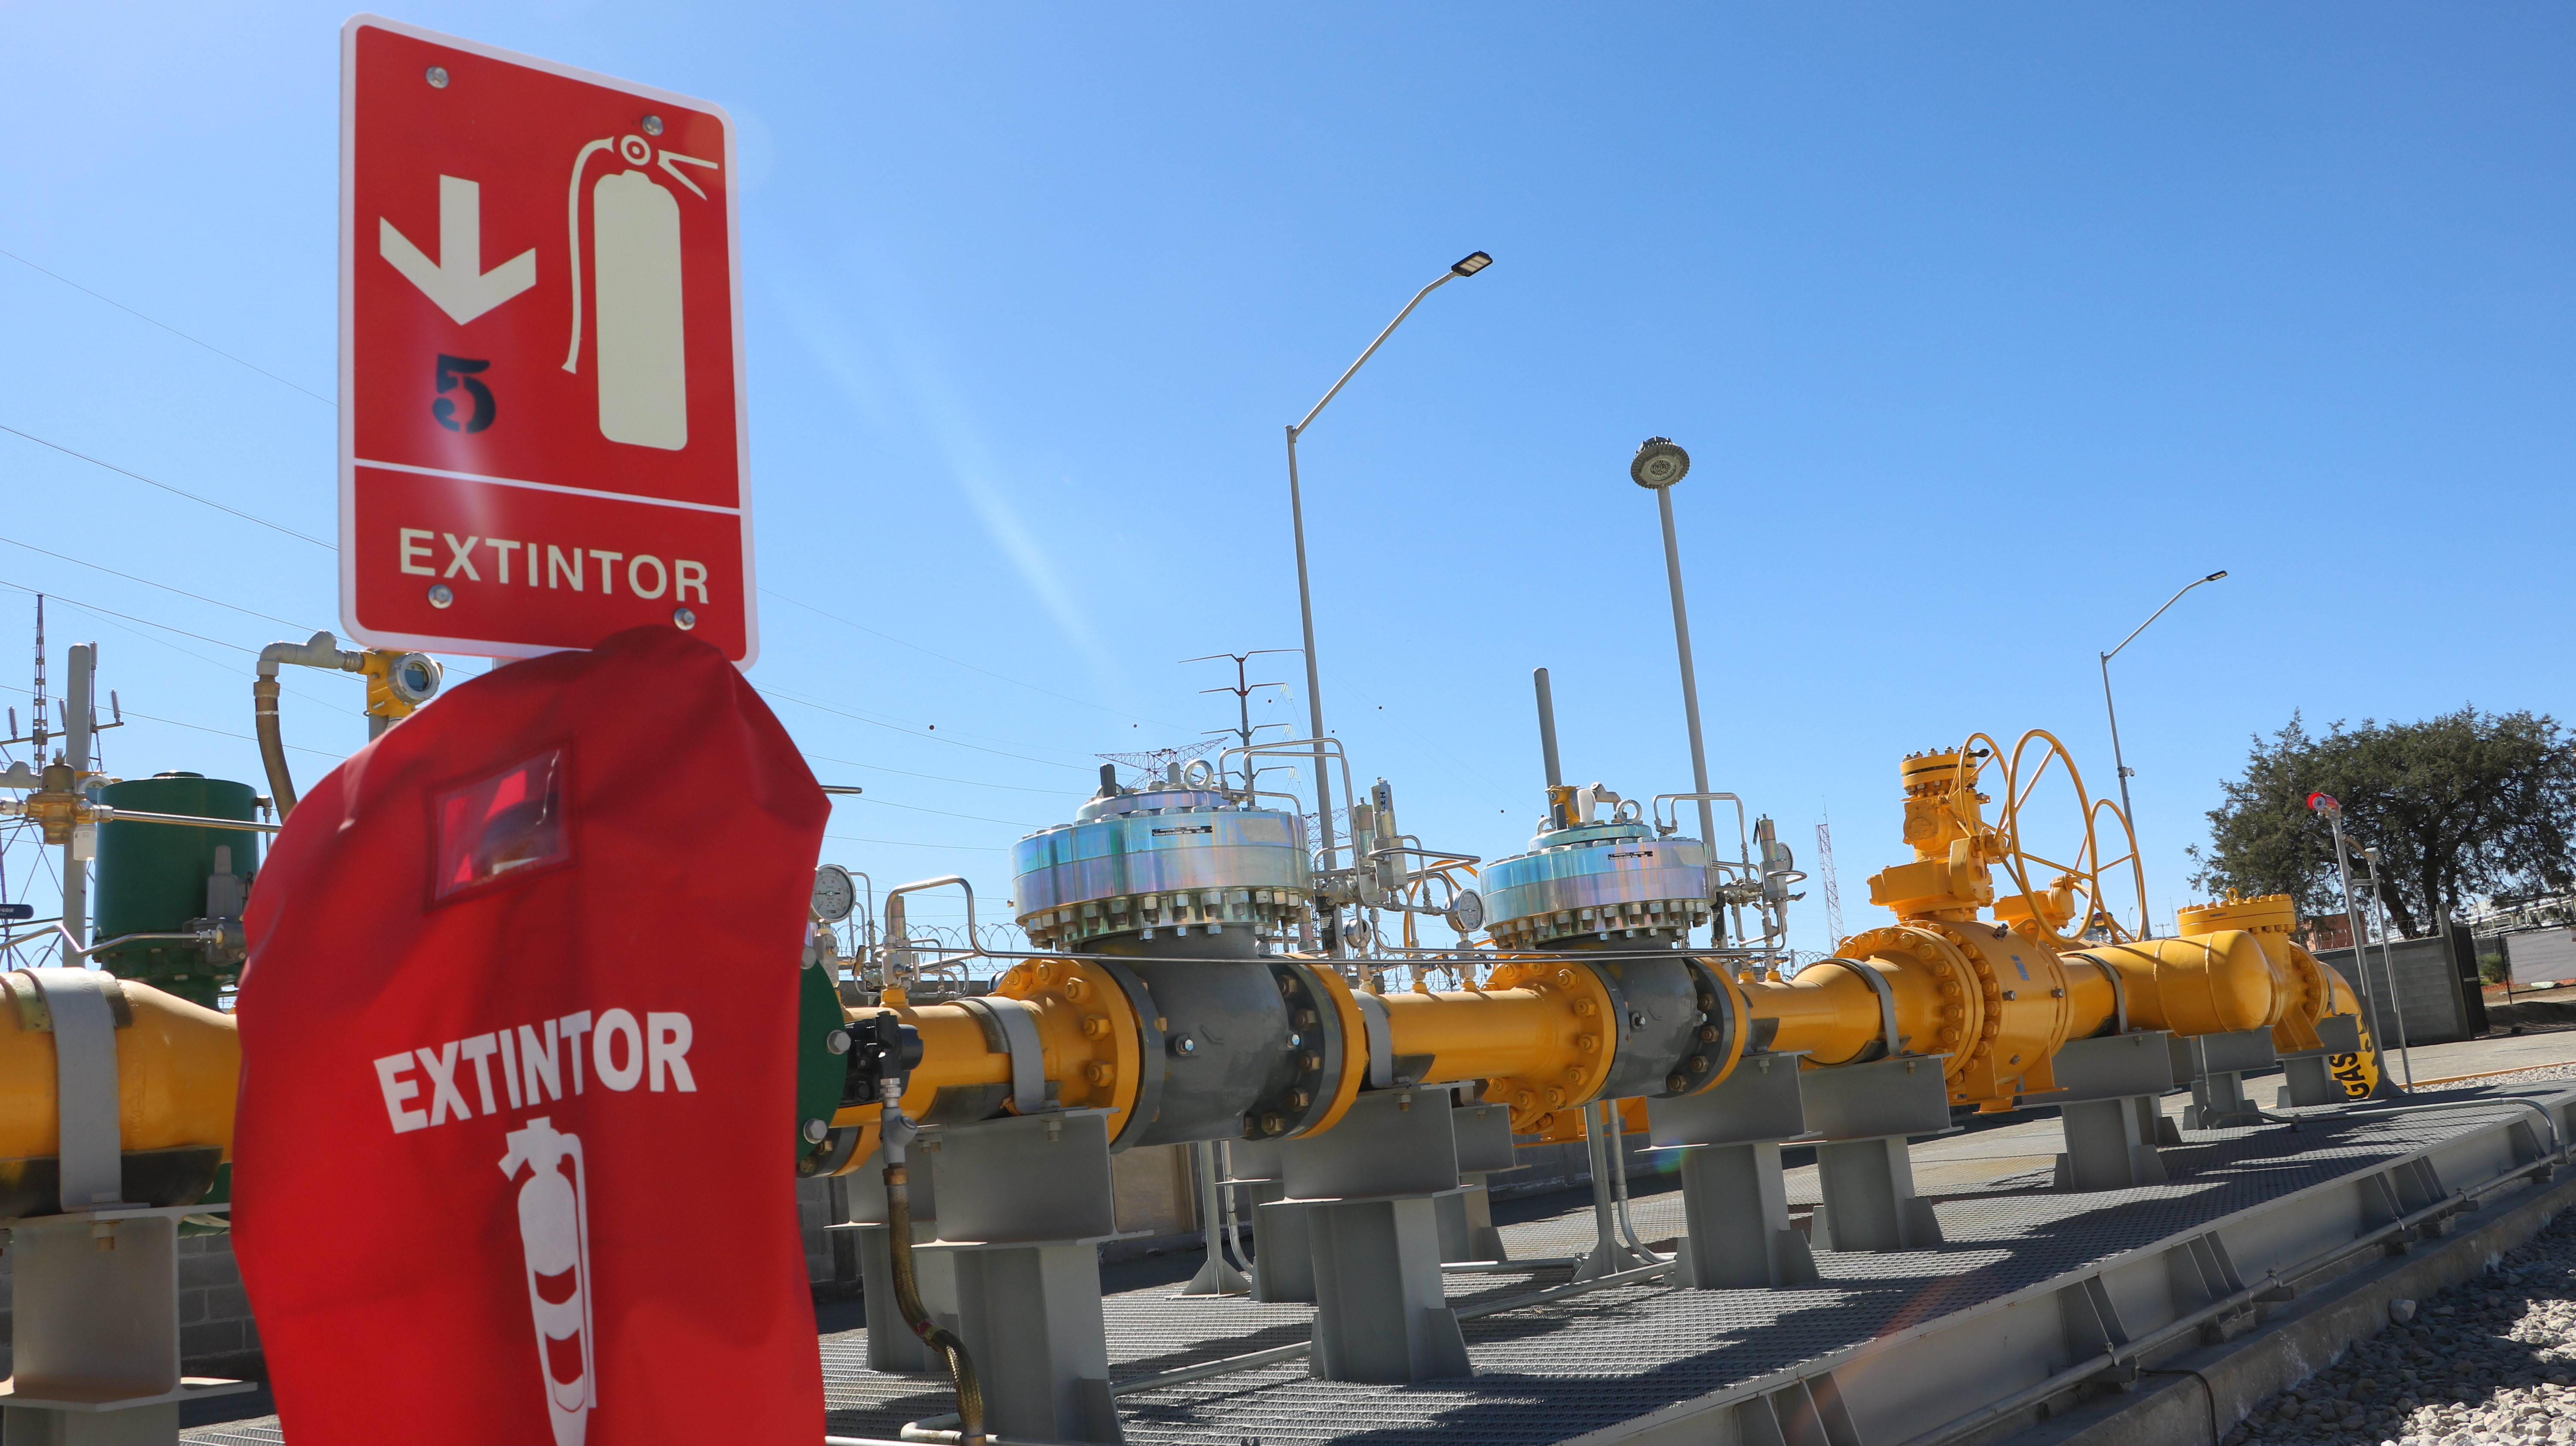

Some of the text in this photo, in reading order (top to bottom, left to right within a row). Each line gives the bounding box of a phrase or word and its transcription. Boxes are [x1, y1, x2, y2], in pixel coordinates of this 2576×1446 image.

[432, 353, 496, 434] 5
[400, 528, 709, 604] EXTINTOR
[374, 1008, 697, 1134] EXTINTOR
[2328, 1052, 2370, 1100] GAS
